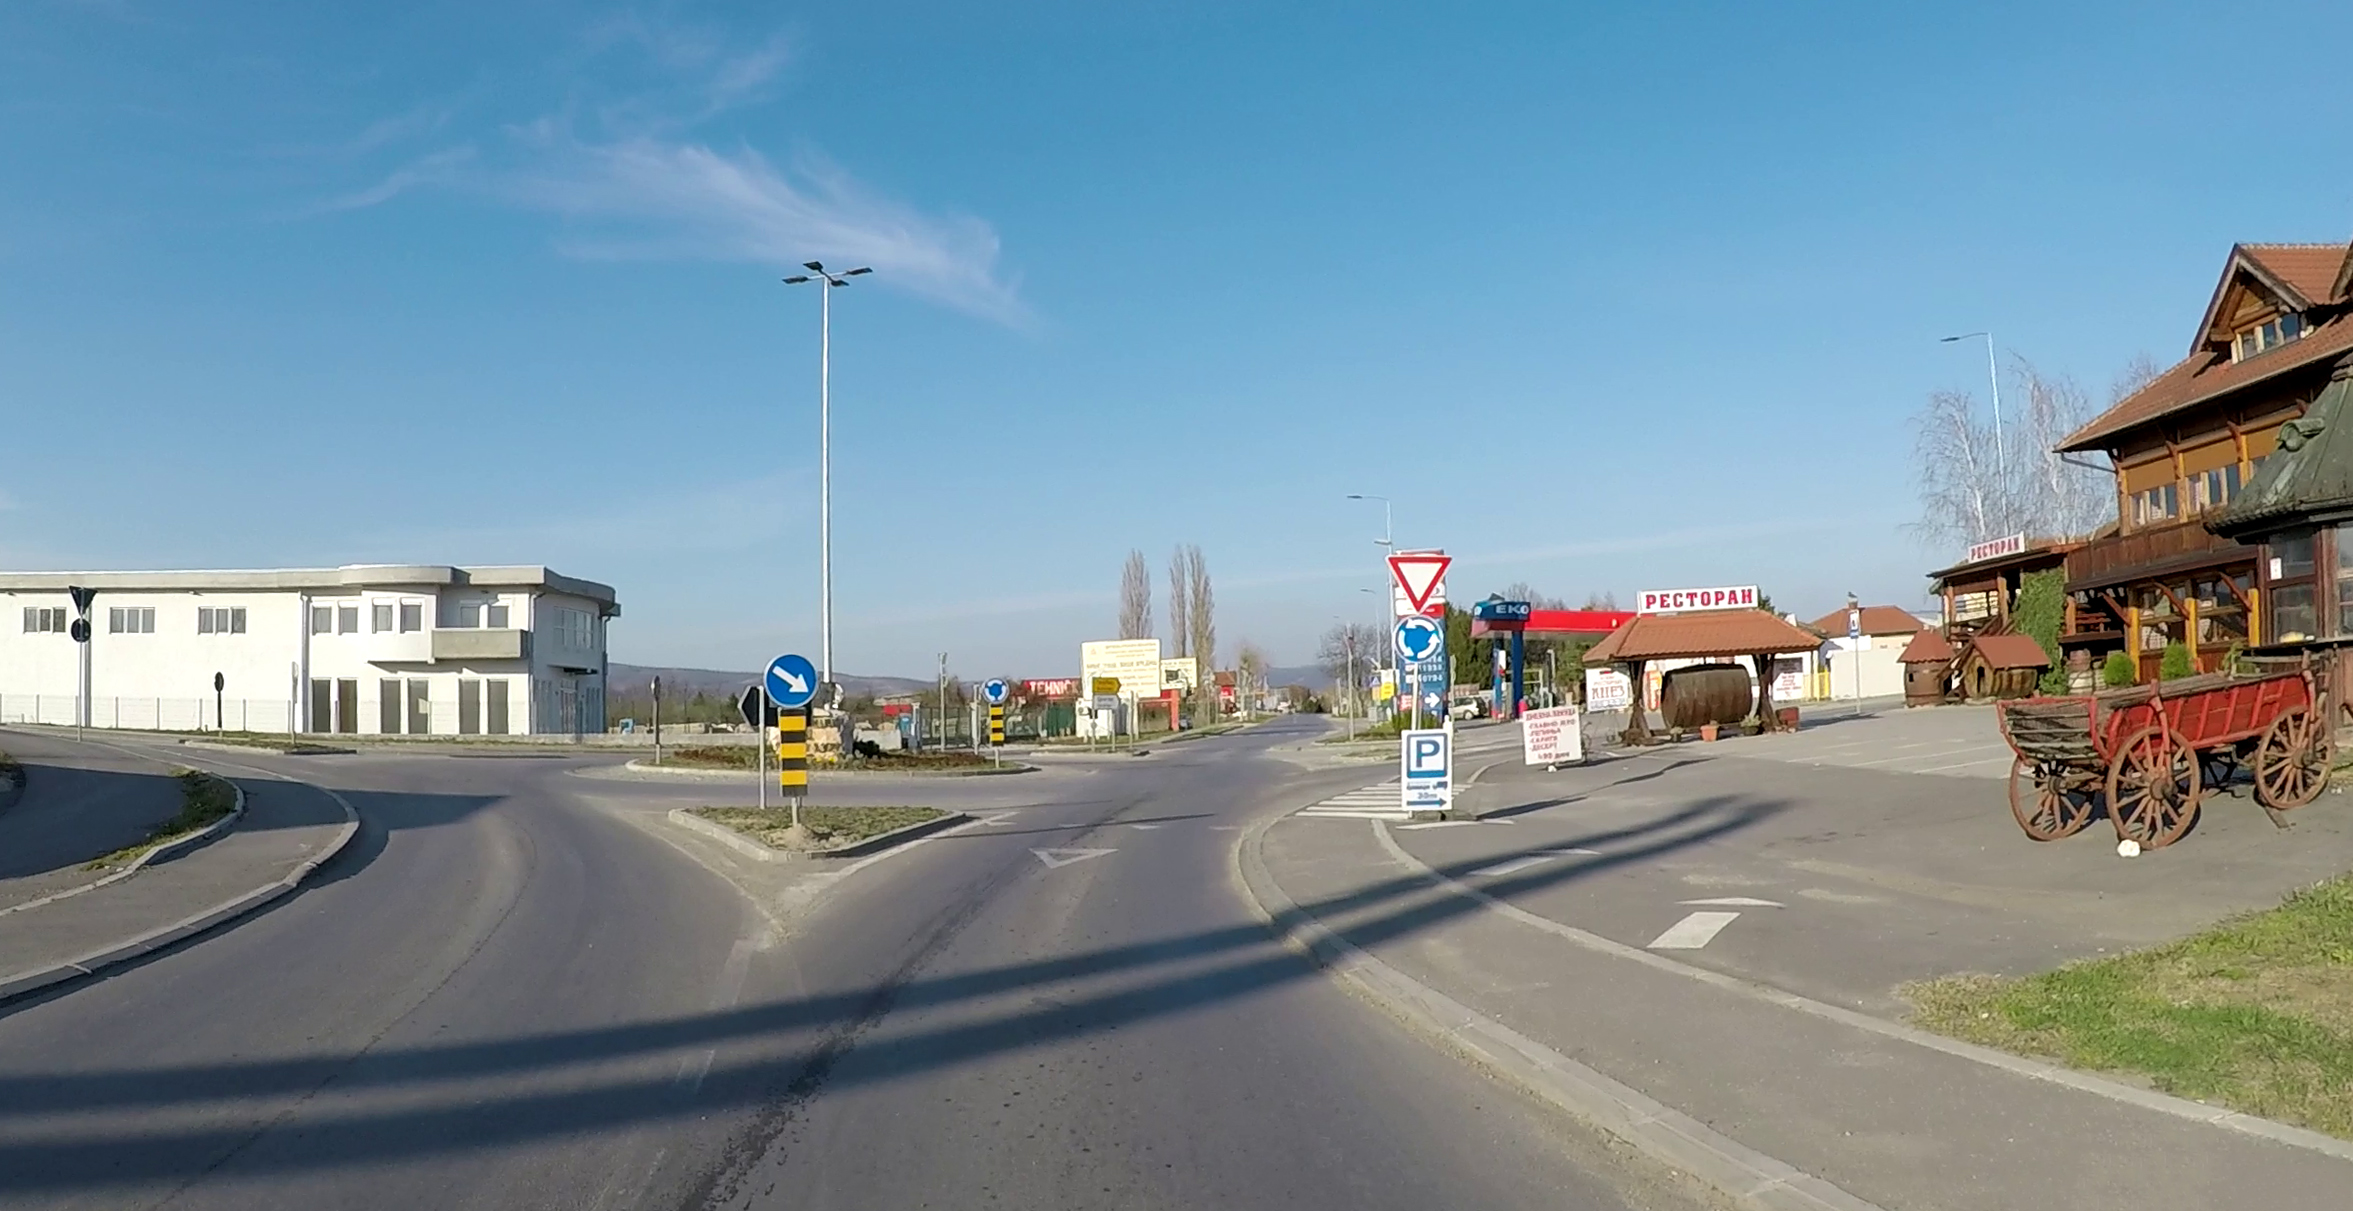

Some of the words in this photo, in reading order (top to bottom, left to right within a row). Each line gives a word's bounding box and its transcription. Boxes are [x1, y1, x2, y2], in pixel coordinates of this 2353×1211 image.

[1970, 537, 2020, 560] РЕСТОРАН
[1495, 603, 1530, 615] EKO
[1645, 588, 1753, 609] РЕСТОРАН
[1416, 740, 1440, 768] P
